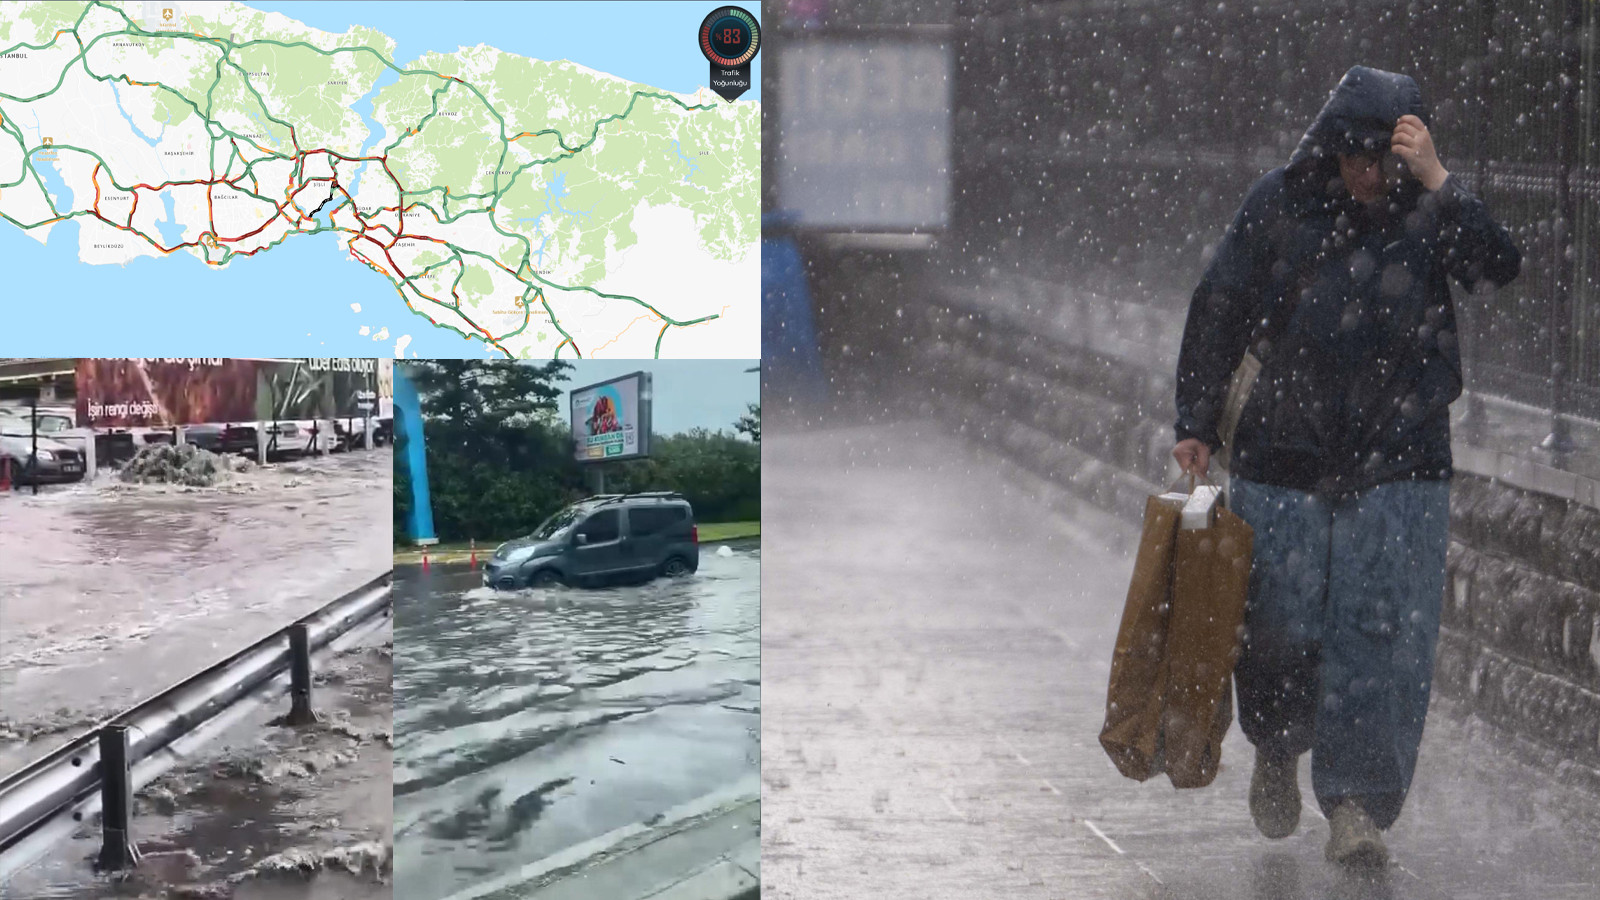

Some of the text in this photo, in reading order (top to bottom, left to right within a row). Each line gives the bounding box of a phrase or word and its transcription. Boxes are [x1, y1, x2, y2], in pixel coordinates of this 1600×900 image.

[713, 80, 748, 88] Yoğunluğu
[87, 398, 103, 421] İşin
[105, 400, 128, 419] rengi
